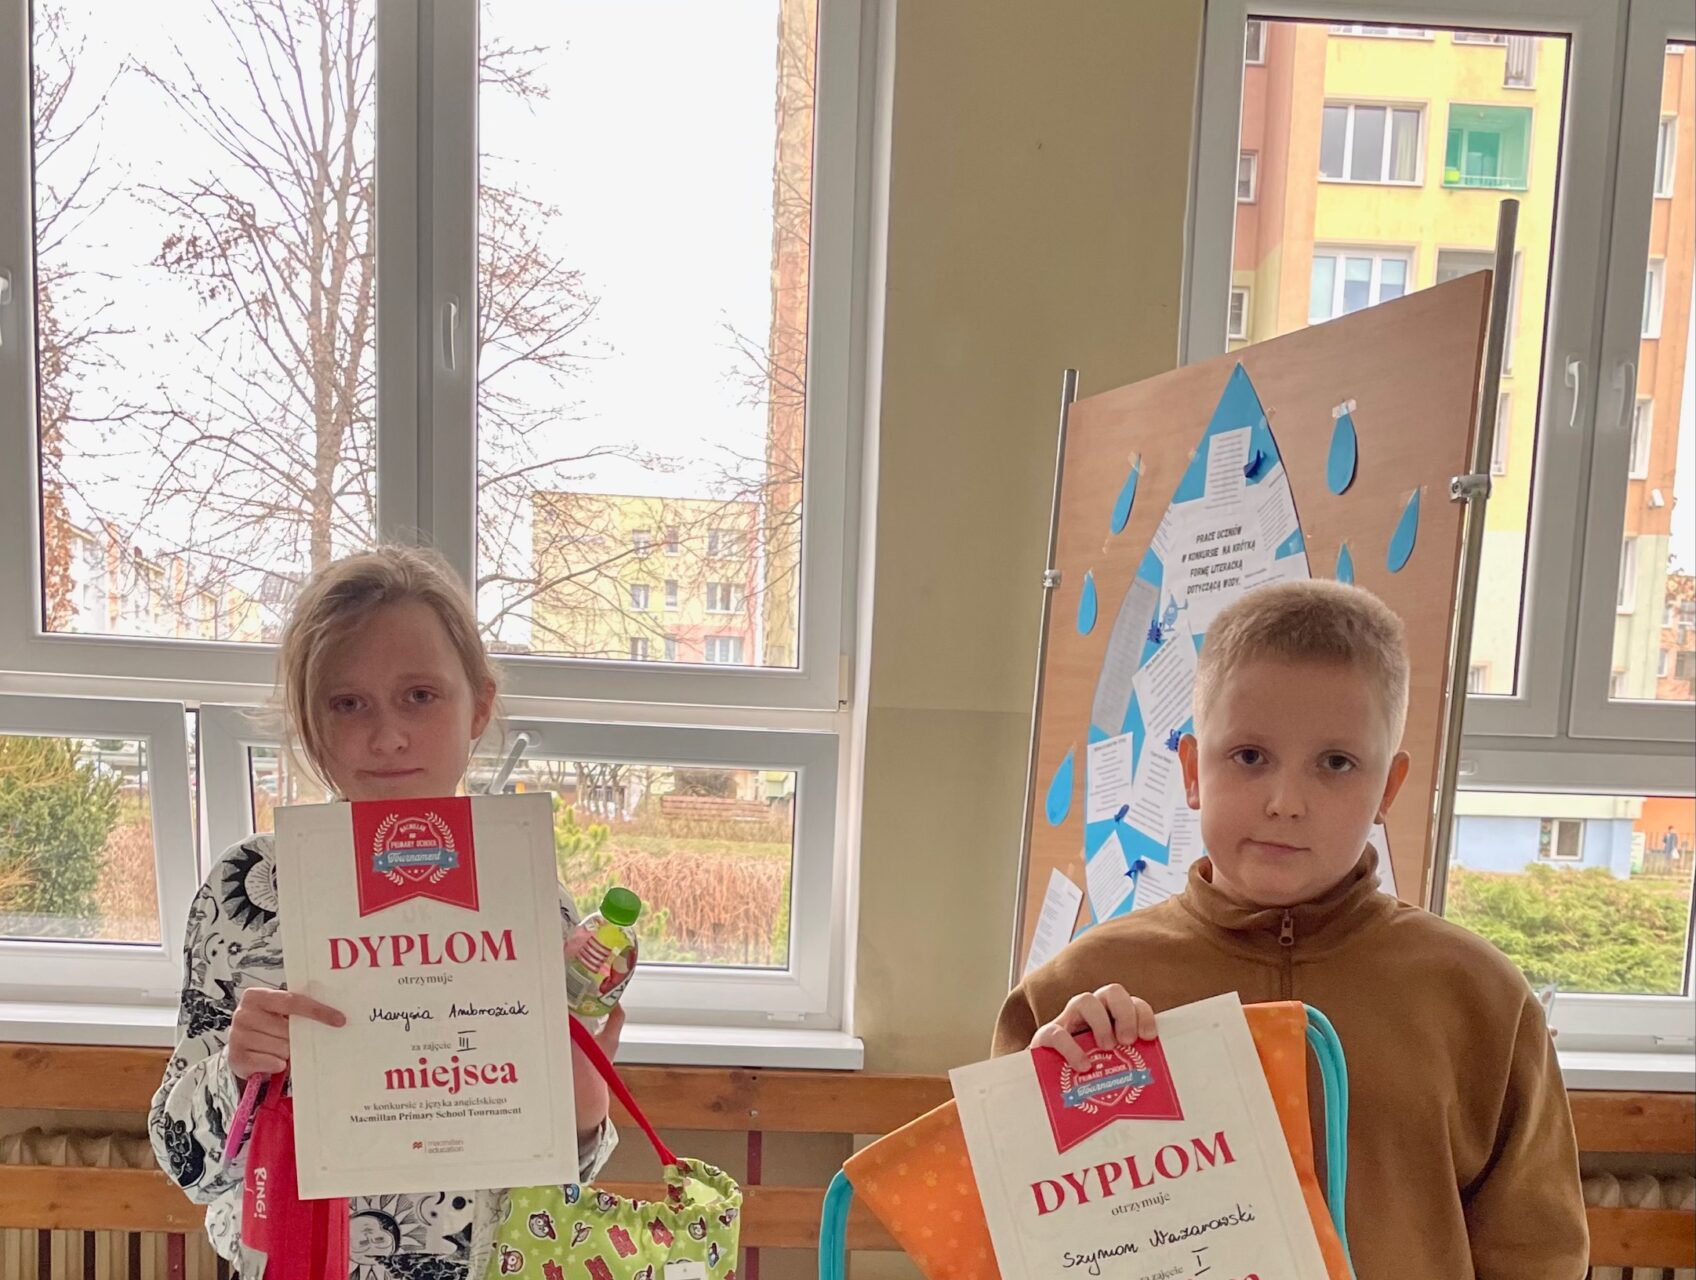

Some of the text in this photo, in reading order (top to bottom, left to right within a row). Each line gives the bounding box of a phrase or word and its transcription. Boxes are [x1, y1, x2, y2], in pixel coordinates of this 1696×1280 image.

[1196, 531, 1216, 544] PRACE
[1188, 547, 1219, 562] KONKURSIE
[1222, 545, 1231, 556] NA
[328, 929, 517, 970] DYPLOM
[397, 973, 453, 986] otrzymuje
[411, 1043, 421, 1051] za
[423, 1041, 451, 1052] zajęcie
[384, 1055, 518, 1094] miejsca
[350, 1106, 522, 1124] Macmillan Primary School Tournament
[373, 1101, 417, 1112] konkursie
[424, 1099, 452, 1111] języka
[454, 1096, 508, 1108] angielskiego
[1029, 1131, 1237, 1217] DYPLOM
[254, 1167, 267, 1219] RING!
[1111, 1191, 1171, 1217] otrzymuje
[1063, 1242, 1139, 1276] Szymon
